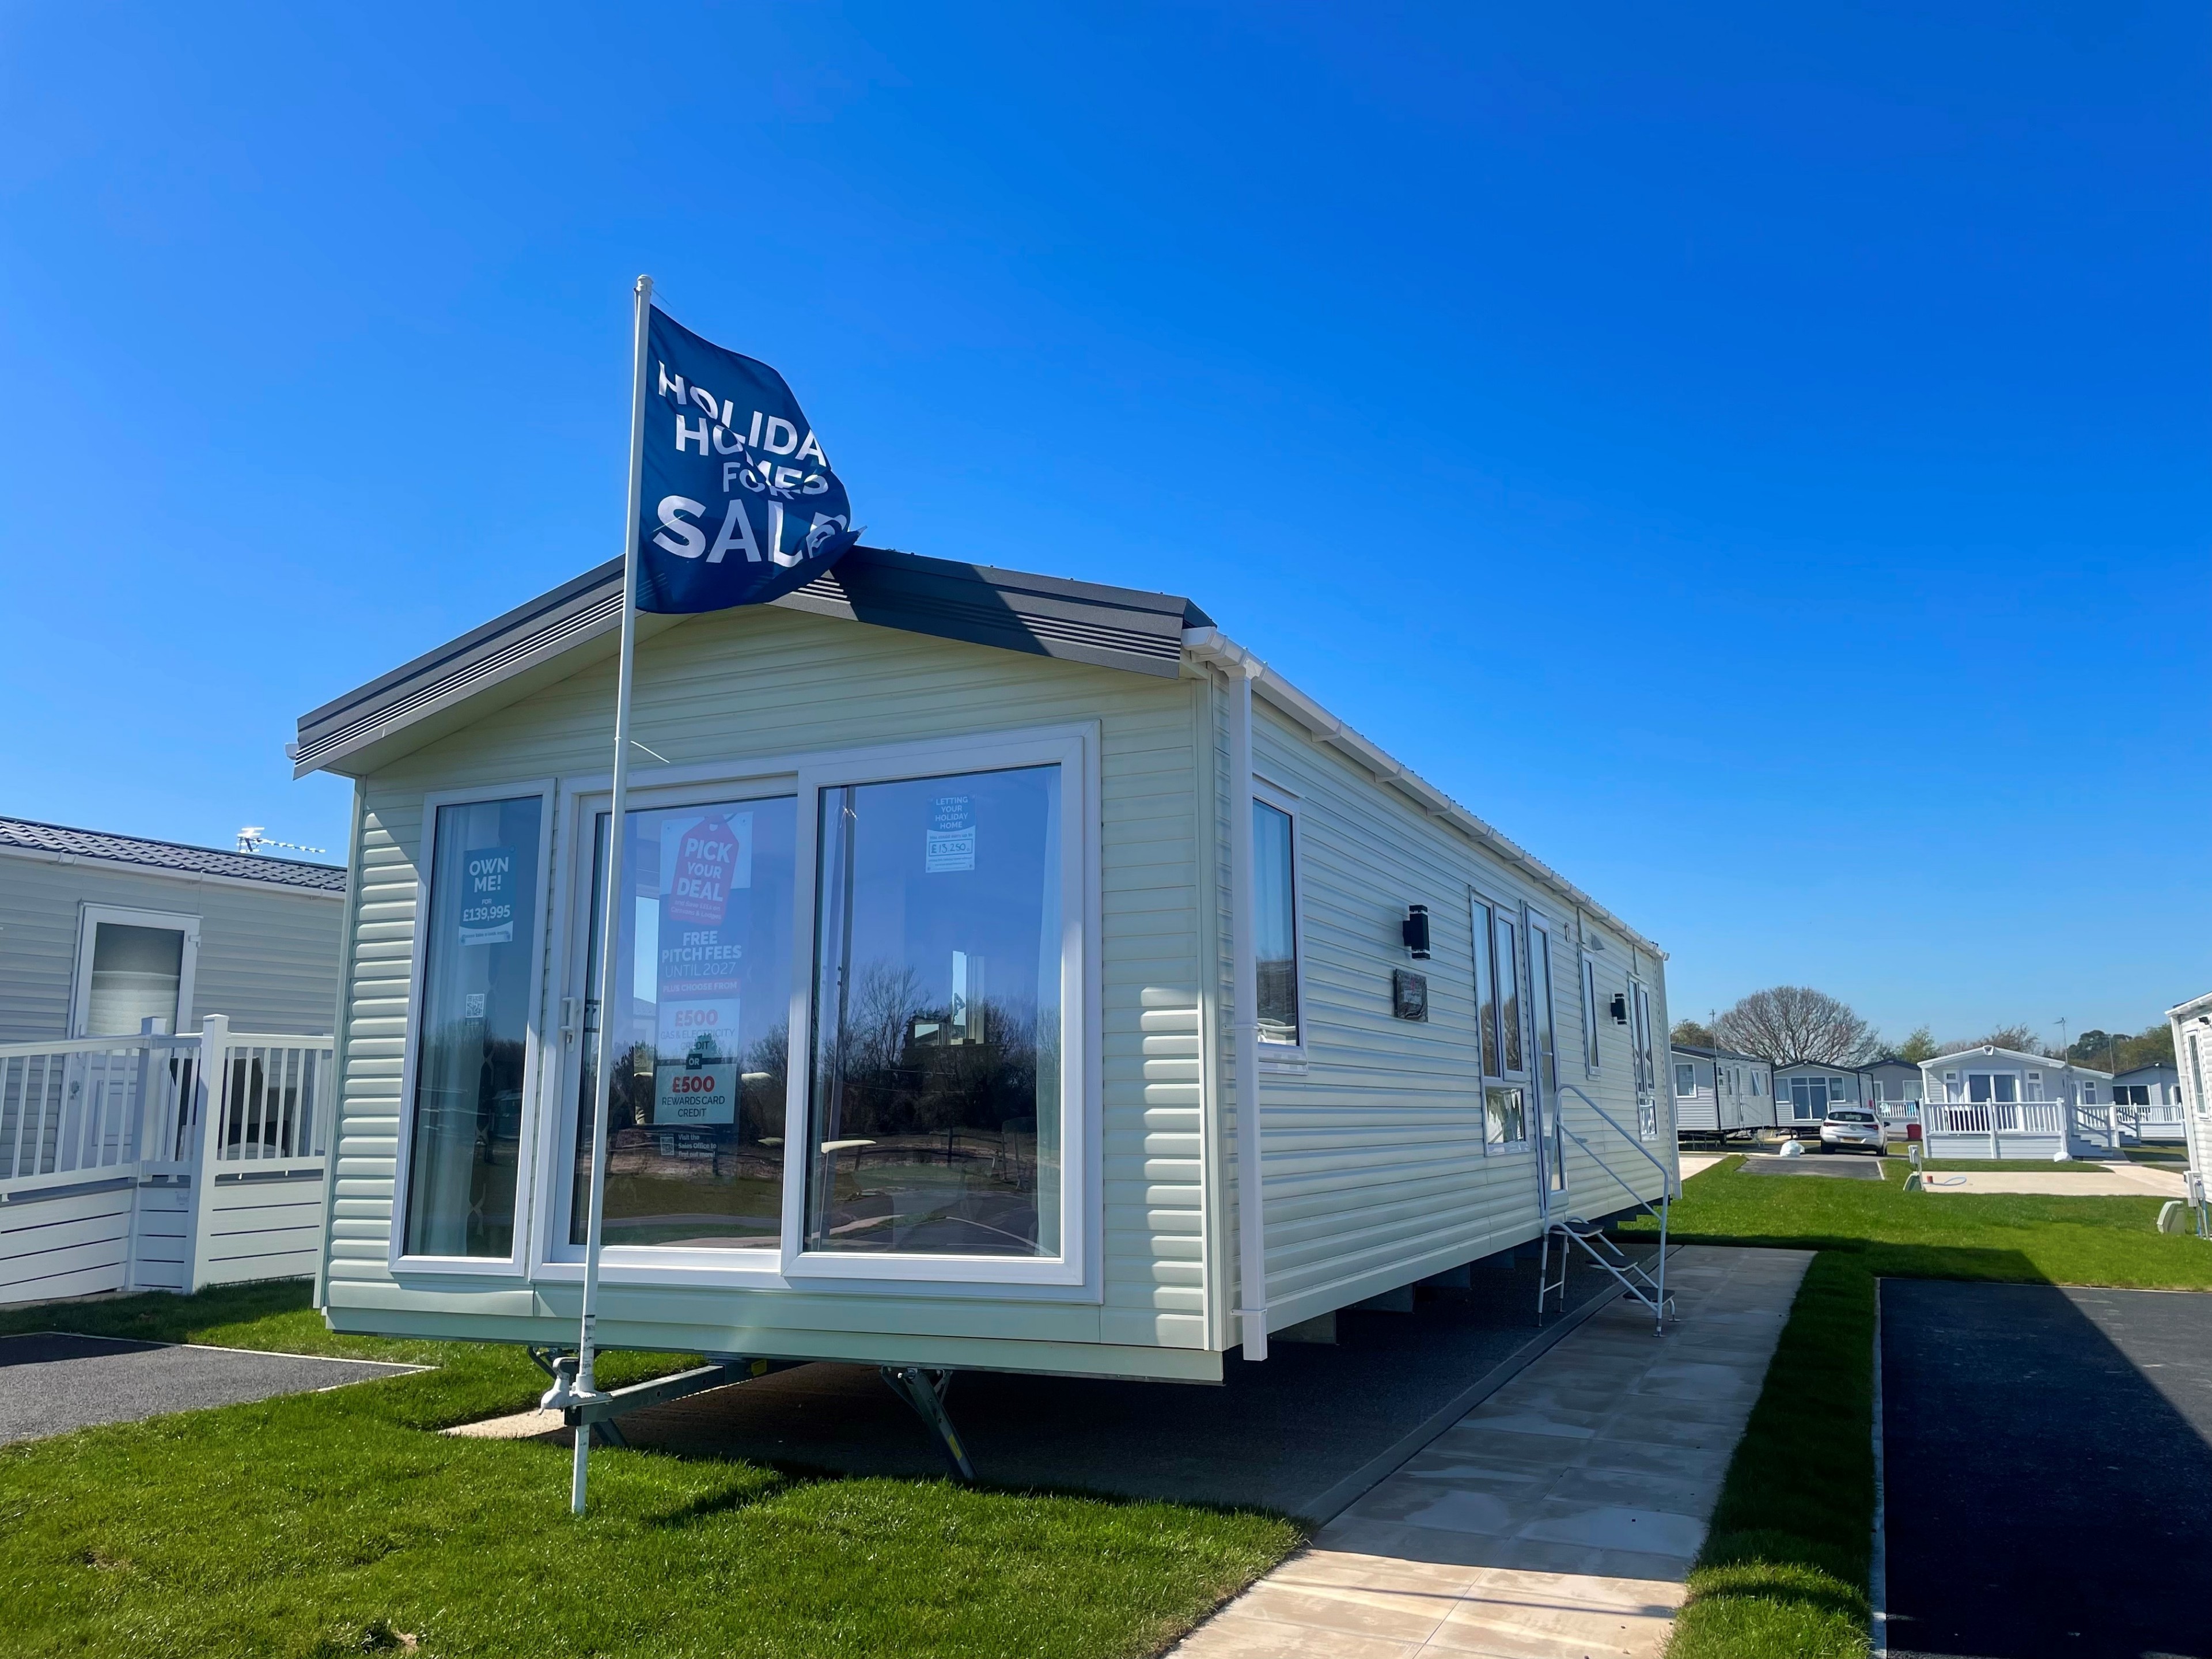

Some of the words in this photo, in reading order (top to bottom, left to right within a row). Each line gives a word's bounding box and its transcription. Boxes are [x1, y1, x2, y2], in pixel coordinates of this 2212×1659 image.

[658, 360, 826, 467] HOLIDA
[936, 796, 968, 805] LETTING
[935, 813, 968, 821] HOLIDAY
[941, 805, 962, 813] YOUR
[940, 821, 963, 830] HOME
[685, 838, 733, 863] PICK
[469, 856, 509, 876] OWN
[687, 862, 722, 879] YOUR
[474, 874, 501, 893] ME!
[676, 877, 723, 902] DEAL
[463, 904, 510, 922] £139,995
[700, 911, 722, 920] Lodges
[683, 930, 718, 946] FREE
[662, 946, 702, 963] PITCH
[705, 945, 742, 960] FEES
[665, 963, 701, 978] UNTIL
[703, 962, 736, 975] 2027
[662, 984, 680, 993] PLUS
[681, 983, 713, 991] CHOOSE
[714, 982, 737, 990] FROM
[675, 1009, 718, 1027] £500
[660, 1030, 675, 1039] GAS
[676, 1030, 681, 1039] &
[682, 1028, 735, 1038] ELECTRICITY
[688, 1058, 700, 1066] OR
[672, 1075, 715, 1093] £500
[661, 1096, 701, 1105] REWARDS
[701, 1096, 725, 1105] CARD
[677, 1108, 707, 1118] CREDIT
